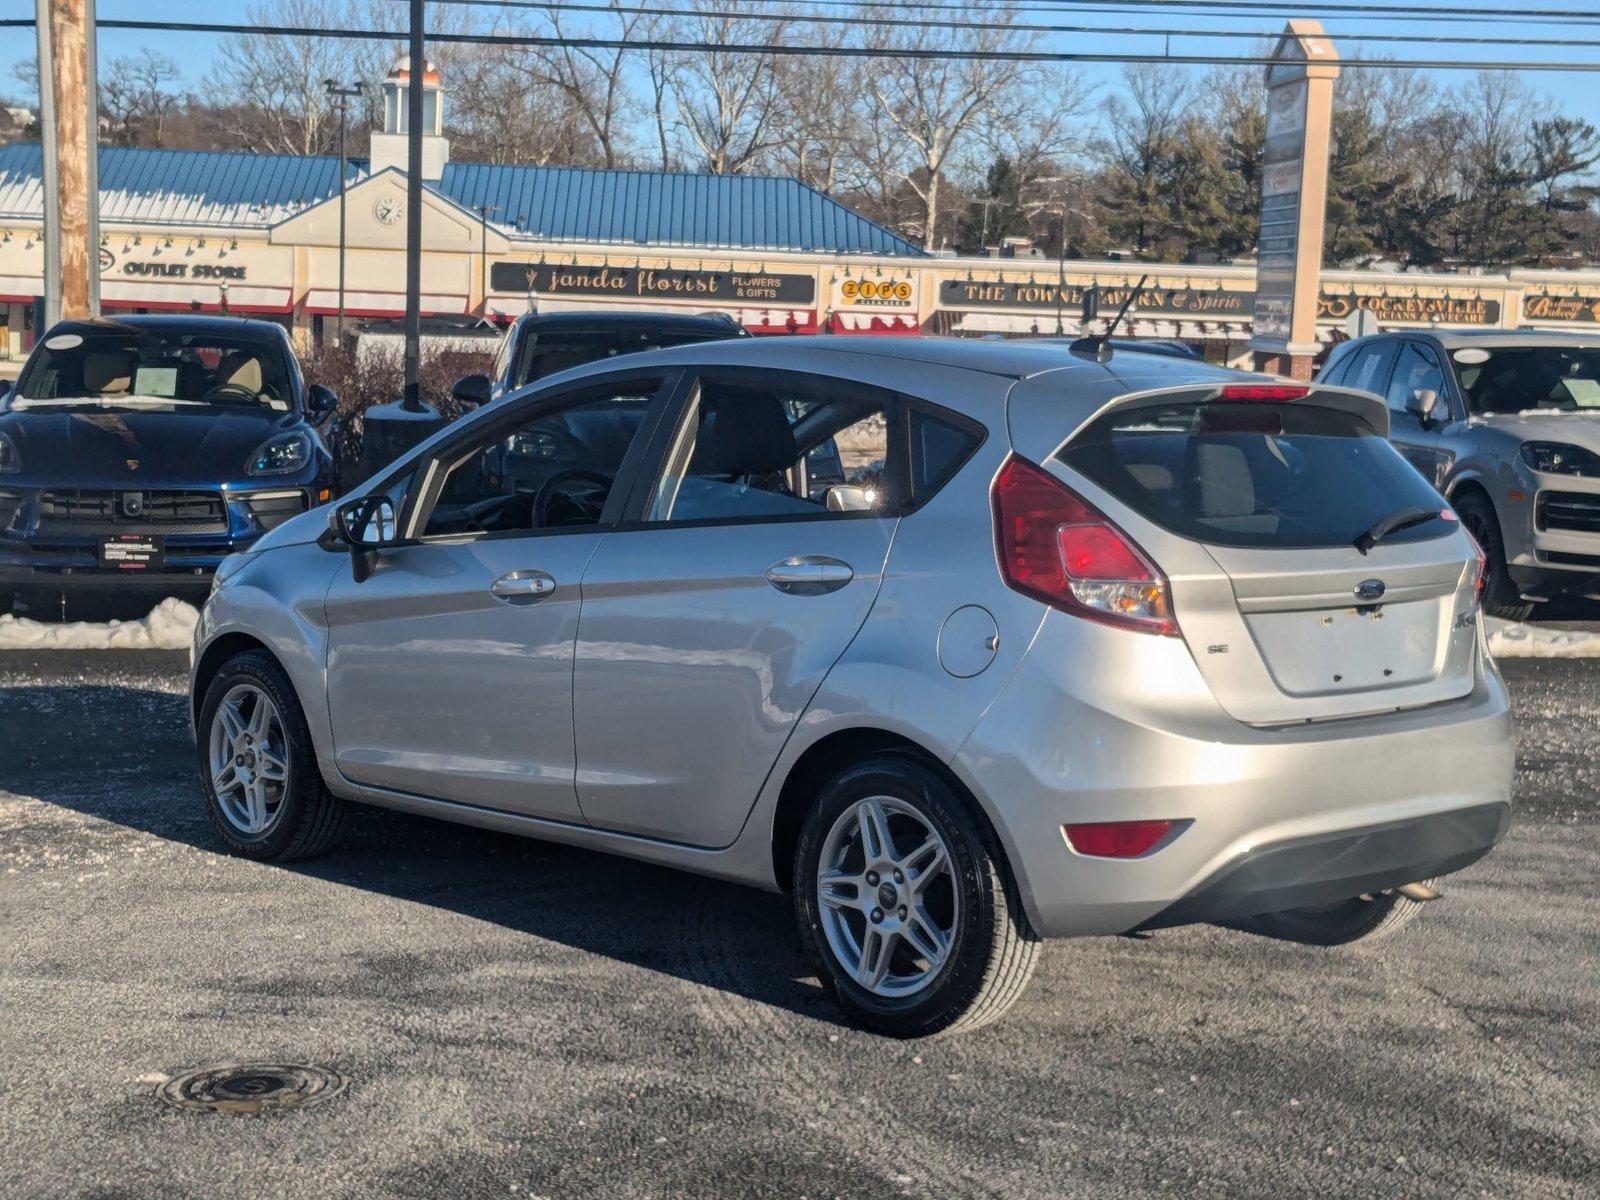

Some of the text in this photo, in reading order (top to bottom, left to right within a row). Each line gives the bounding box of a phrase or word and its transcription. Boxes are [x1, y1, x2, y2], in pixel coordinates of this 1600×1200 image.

[123, 261, 247, 280] OUTLET STORE
[549, 269, 719, 295] janda florist
[732, 277, 782, 288] FLOWERS
[736, 288, 777, 298] & GIFTS
[965, 285, 1006, 301] THE
[1099, 290, 1165, 307] AVRN
[1189, 294, 1241, 311] Spirits
[860, 299, 907, 307] CLEANERS
[1440, 312, 1486, 324] YECARE
[1207, 644, 1229, 654] SE
